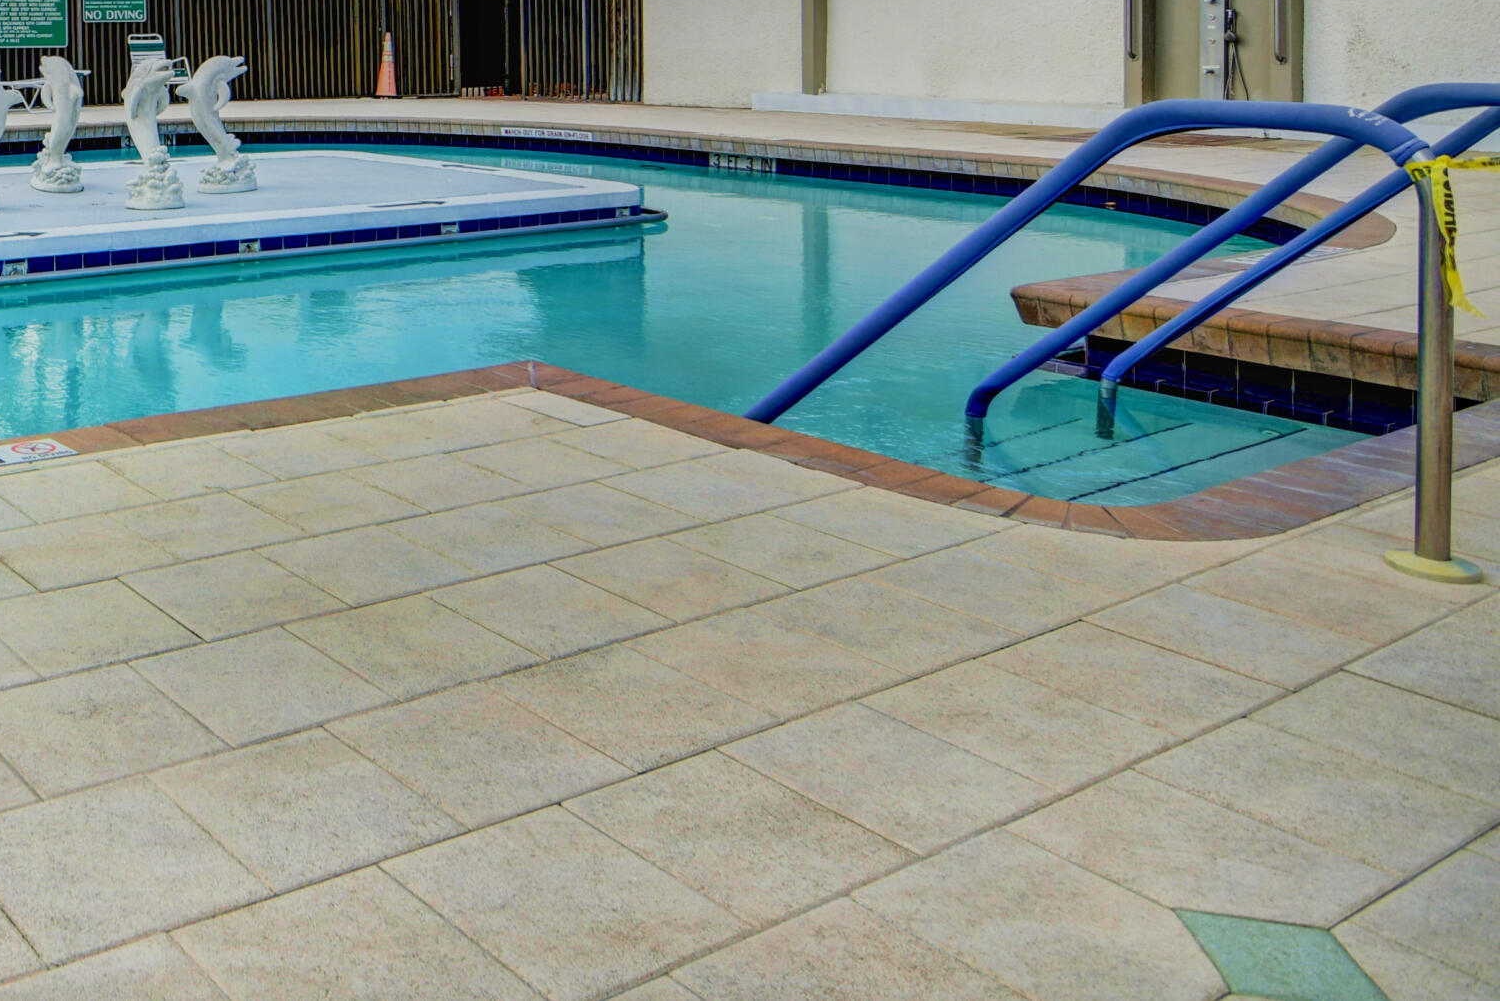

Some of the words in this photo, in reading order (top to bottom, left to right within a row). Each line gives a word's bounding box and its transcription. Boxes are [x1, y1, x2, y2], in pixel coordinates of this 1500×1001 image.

[85, 10, 102, 19] NO
[106, 10, 143, 19] DIVING
[124, 135, 131, 147] 3
[713, 154, 721, 168] 3
[727, 154, 740, 170] FT
[746, 157, 754, 171] 3
[761, 158, 773, 172] IN
